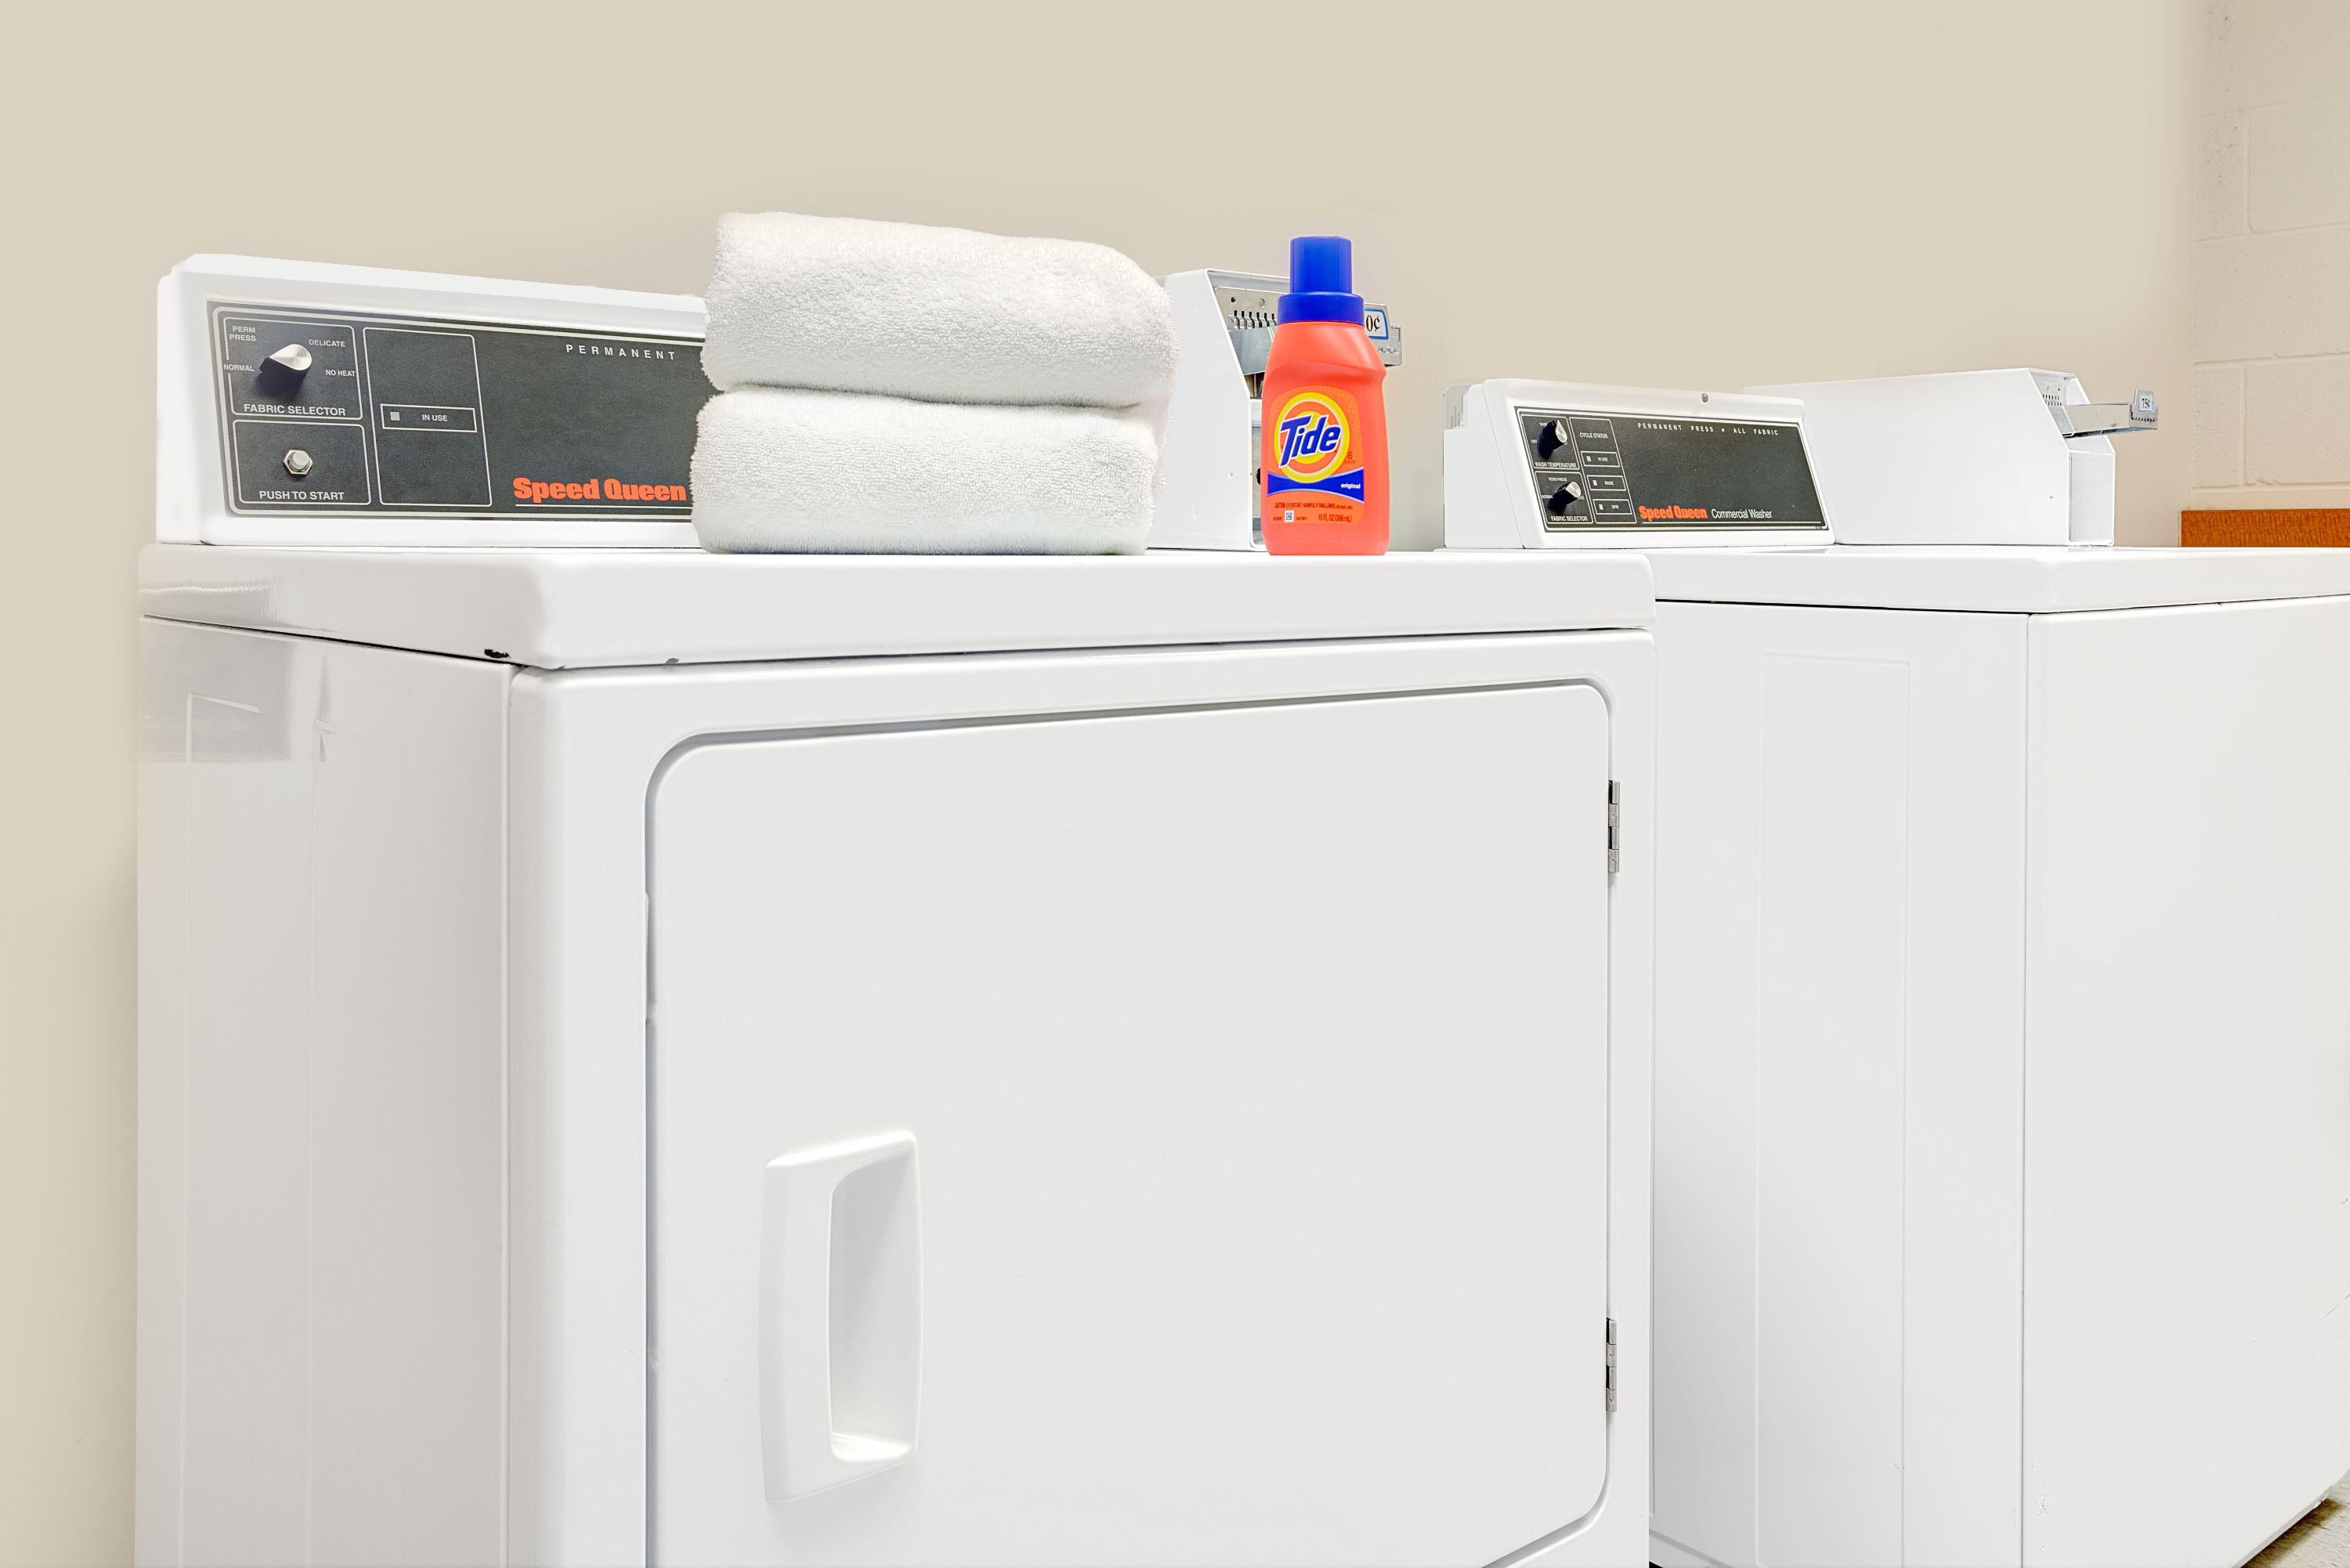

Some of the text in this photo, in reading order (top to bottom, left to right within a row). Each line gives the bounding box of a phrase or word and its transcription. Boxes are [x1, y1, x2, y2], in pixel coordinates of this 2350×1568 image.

[1366, 315, 1381, 332] 0¢
[309, 339, 346, 347] DELICATE
[566, 344, 675, 360] PERMANENT
[244, 404, 346, 416] FABRIC SELECTOR
[1278, 413, 1342, 469] Tide
[259, 491, 344, 500] PUSH TO START
[513, 477, 687, 504] Speed Queen
[1638, 505, 1772, 522] Speed Queen Commercial Washer
